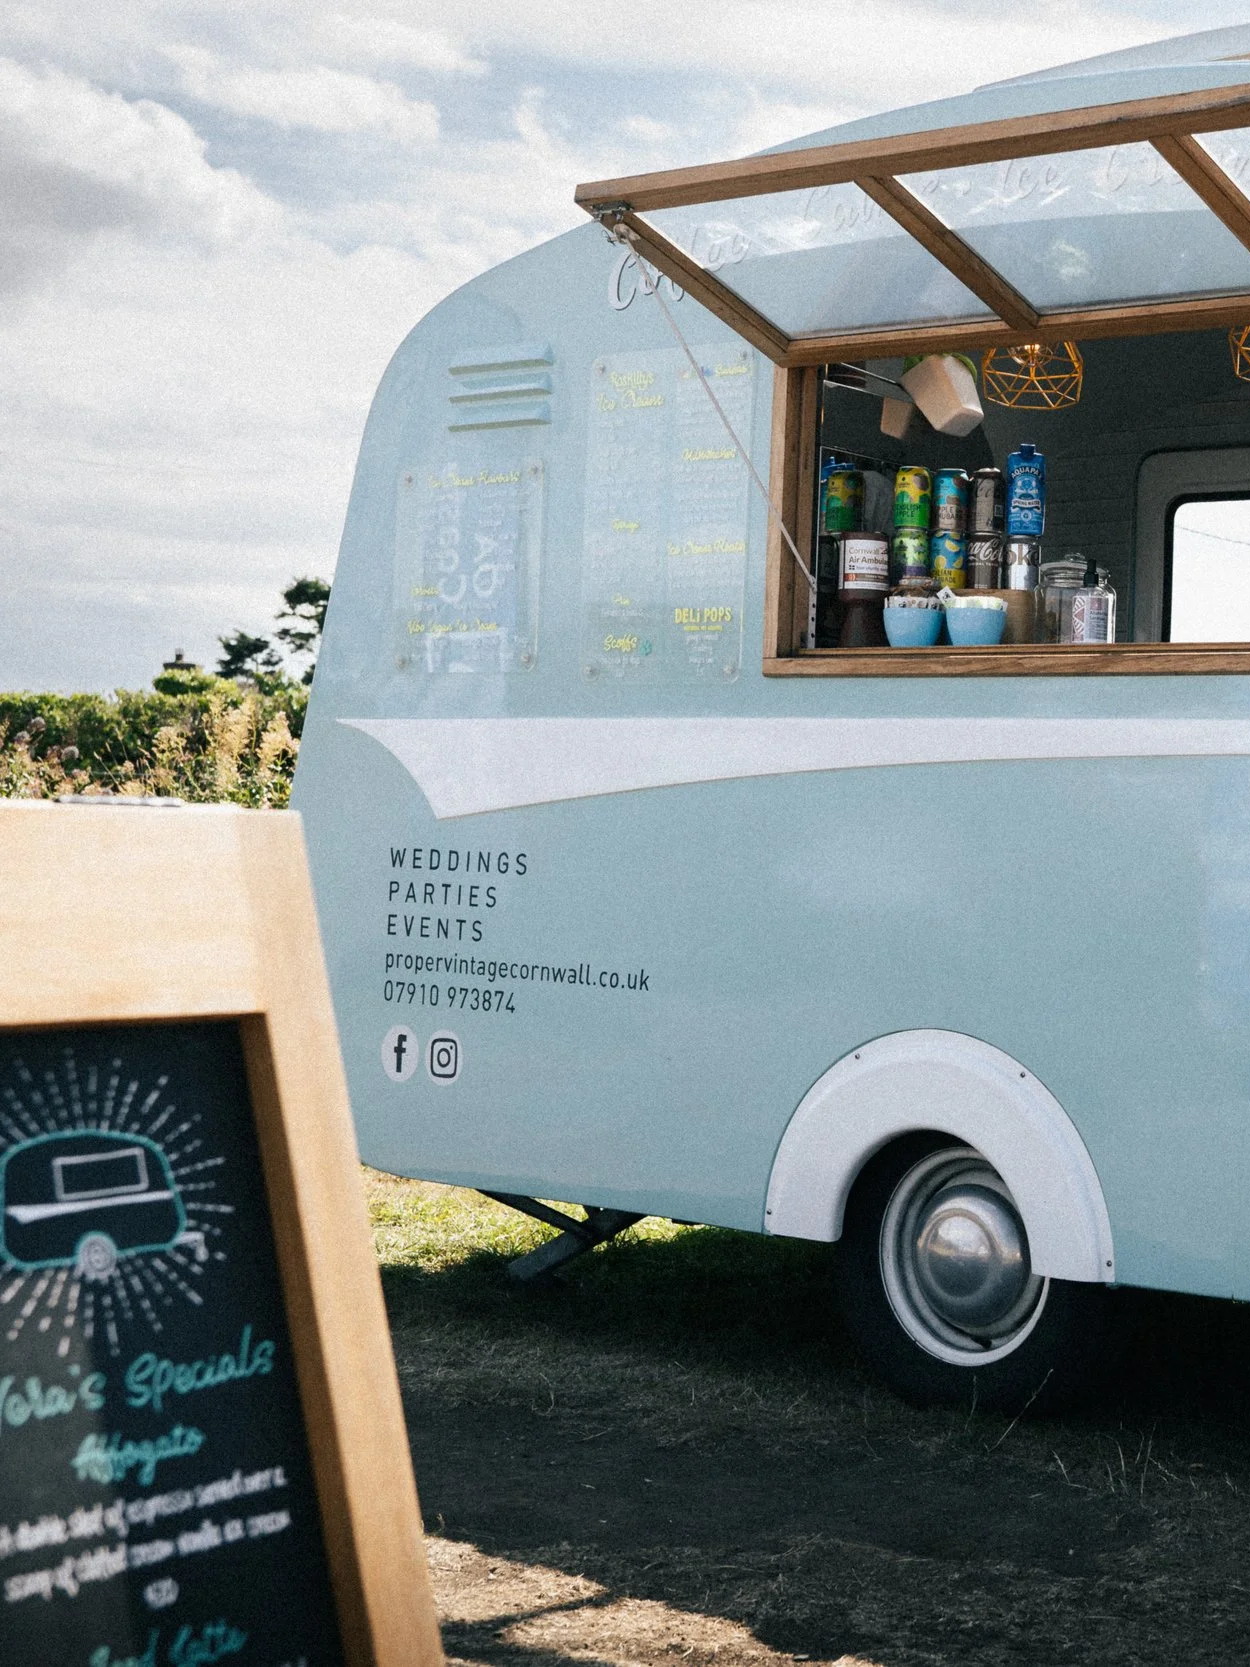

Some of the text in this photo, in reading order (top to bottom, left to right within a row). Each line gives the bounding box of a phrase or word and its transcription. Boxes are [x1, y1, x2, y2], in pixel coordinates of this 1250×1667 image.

[849, 547, 879, 555] Cornwall
[849, 556, 859, 564] Air
[704, 607, 731, 622] POPS
[390, 847, 528, 876] WEDDINGS
[389, 881, 497, 908] PARTIES
[387, 914, 483, 942] EVENTS
[385, 952, 650, 992] propervintagecornwall.co.uk
[384, 980, 516, 1014] 07910 973874
[124, 1323, 276, 1413] Specials
[70, 1423, 206, 1486] Affogato
